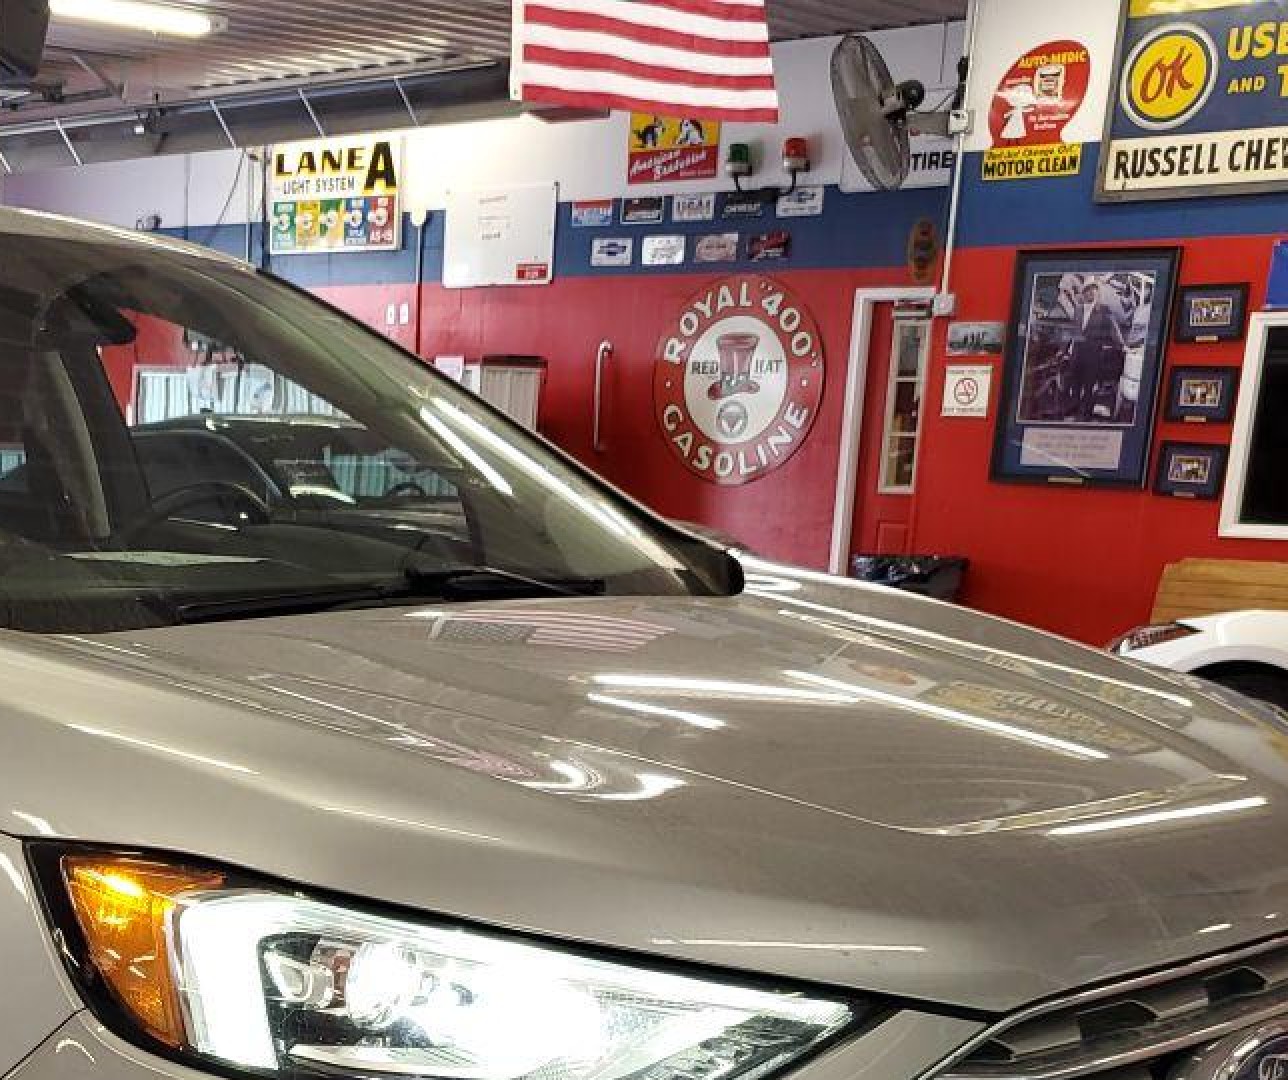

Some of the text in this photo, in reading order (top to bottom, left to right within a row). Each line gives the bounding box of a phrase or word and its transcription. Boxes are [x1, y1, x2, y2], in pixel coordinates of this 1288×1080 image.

[1140, 45, 1194, 103] OK
[276, 141, 397, 192] LANE A
[911, 151, 953, 172] TIRE
[984, 154, 1078, 178] MOTOR CLEAN
[1113, 142, 1220, 181] RUSSELL
[284, 175, 355, 195] LIGHT SYSTEM
[663, 281, 753, 365] ROYAL
[691, 359, 719, 375] RED
[663, 401, 809, 476] GASOLINE
